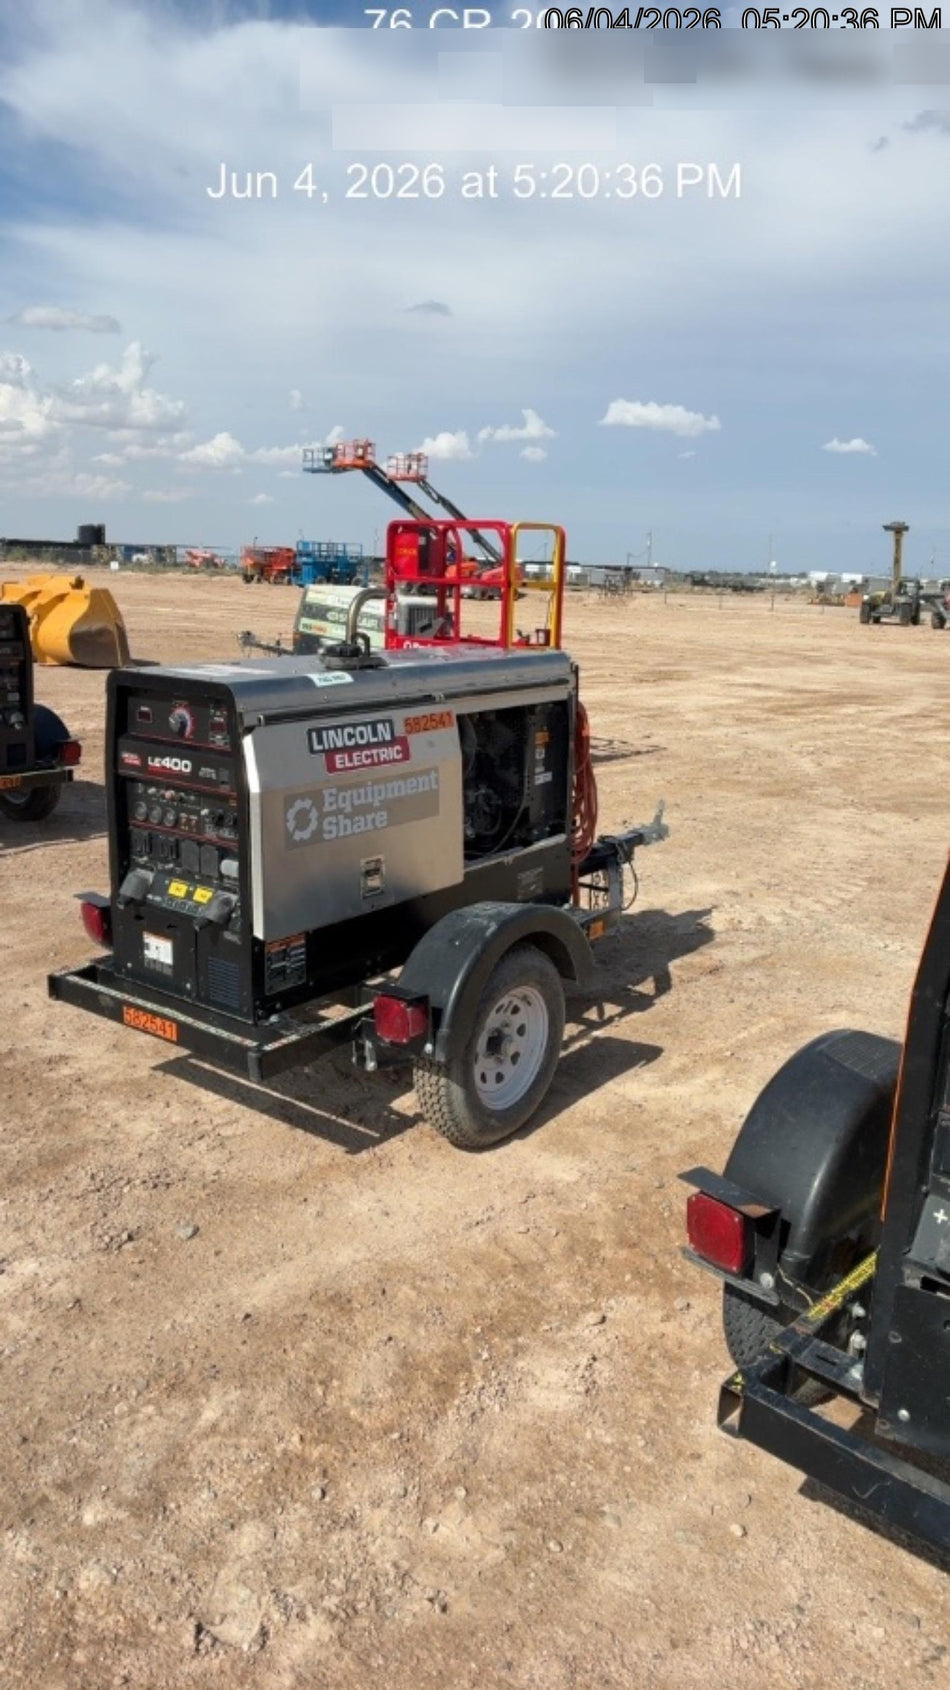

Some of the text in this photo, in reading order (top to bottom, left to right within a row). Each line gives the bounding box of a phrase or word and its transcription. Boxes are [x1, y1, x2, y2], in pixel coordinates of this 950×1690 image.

[310, 722, 392, 751] LINCOLN
[404, 711, 453, 734] 582541
[335, 745, 403, 769] ELECTRIC
[322, 770, 439, 813] Equipment
[322, 810, 388, 840] Share
[124, 1006, 176, 1040] 582541
